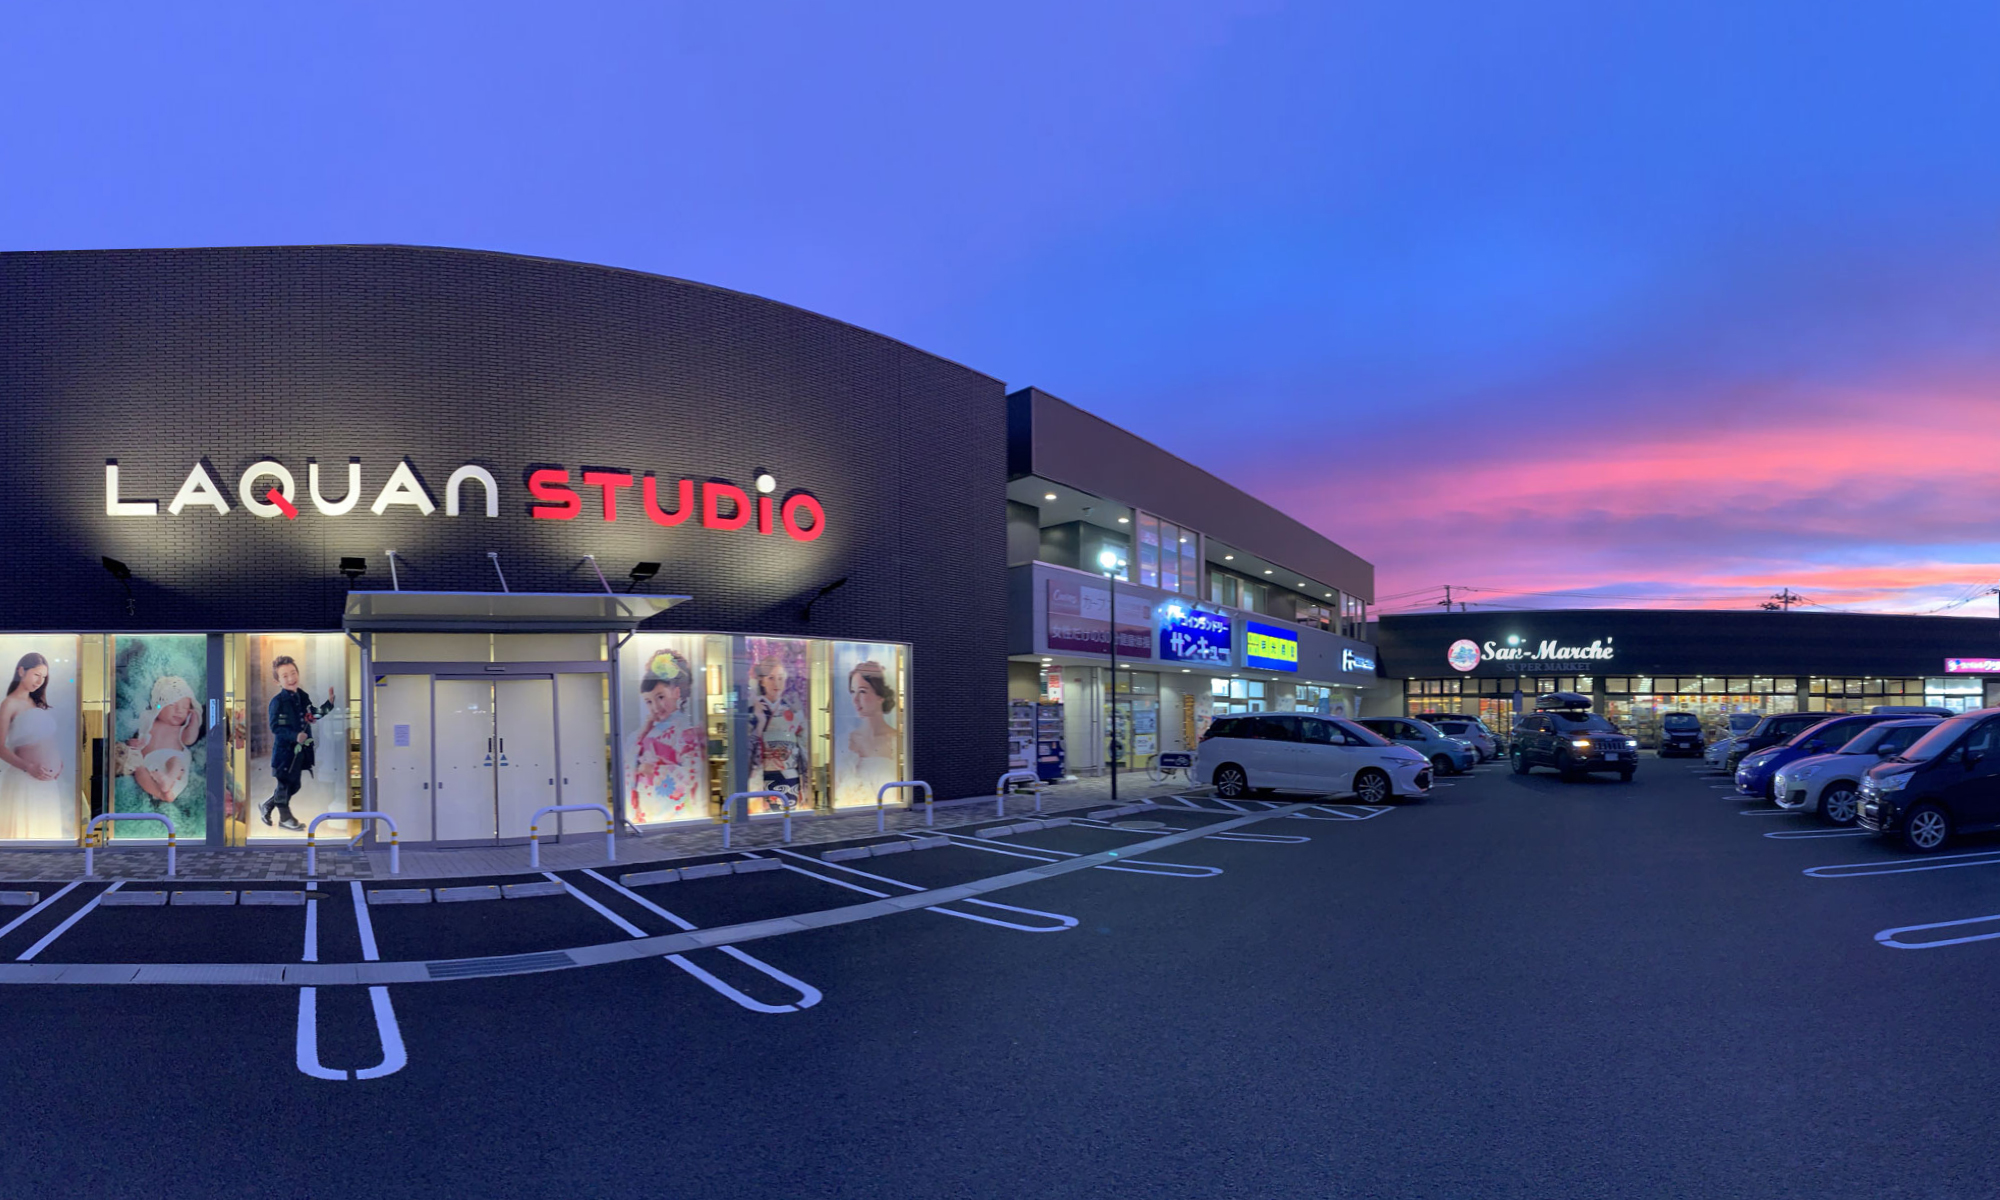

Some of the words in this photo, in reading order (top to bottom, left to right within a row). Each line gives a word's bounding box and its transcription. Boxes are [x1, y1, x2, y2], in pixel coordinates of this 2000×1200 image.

[1170, 631, 1231, 660] サンキュー
[1545, 662, 1591, 671] MARKET
